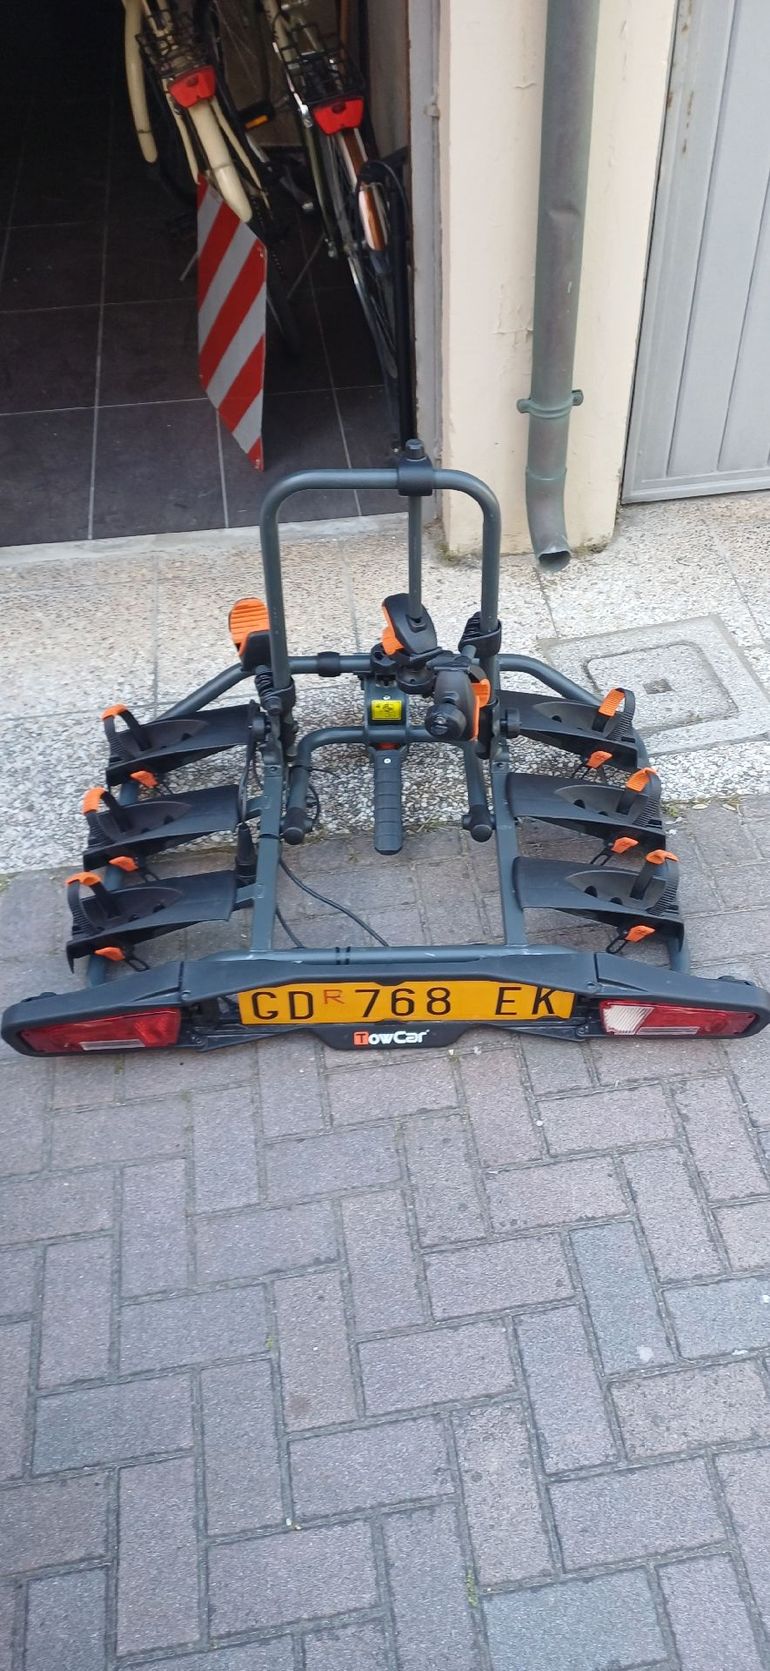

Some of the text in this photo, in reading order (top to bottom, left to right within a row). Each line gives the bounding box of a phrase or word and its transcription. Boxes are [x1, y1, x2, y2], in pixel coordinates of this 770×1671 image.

[251, 986, 556, 1020] GD R 768 EK
[354, 1030, 428, 1045] TowCar
